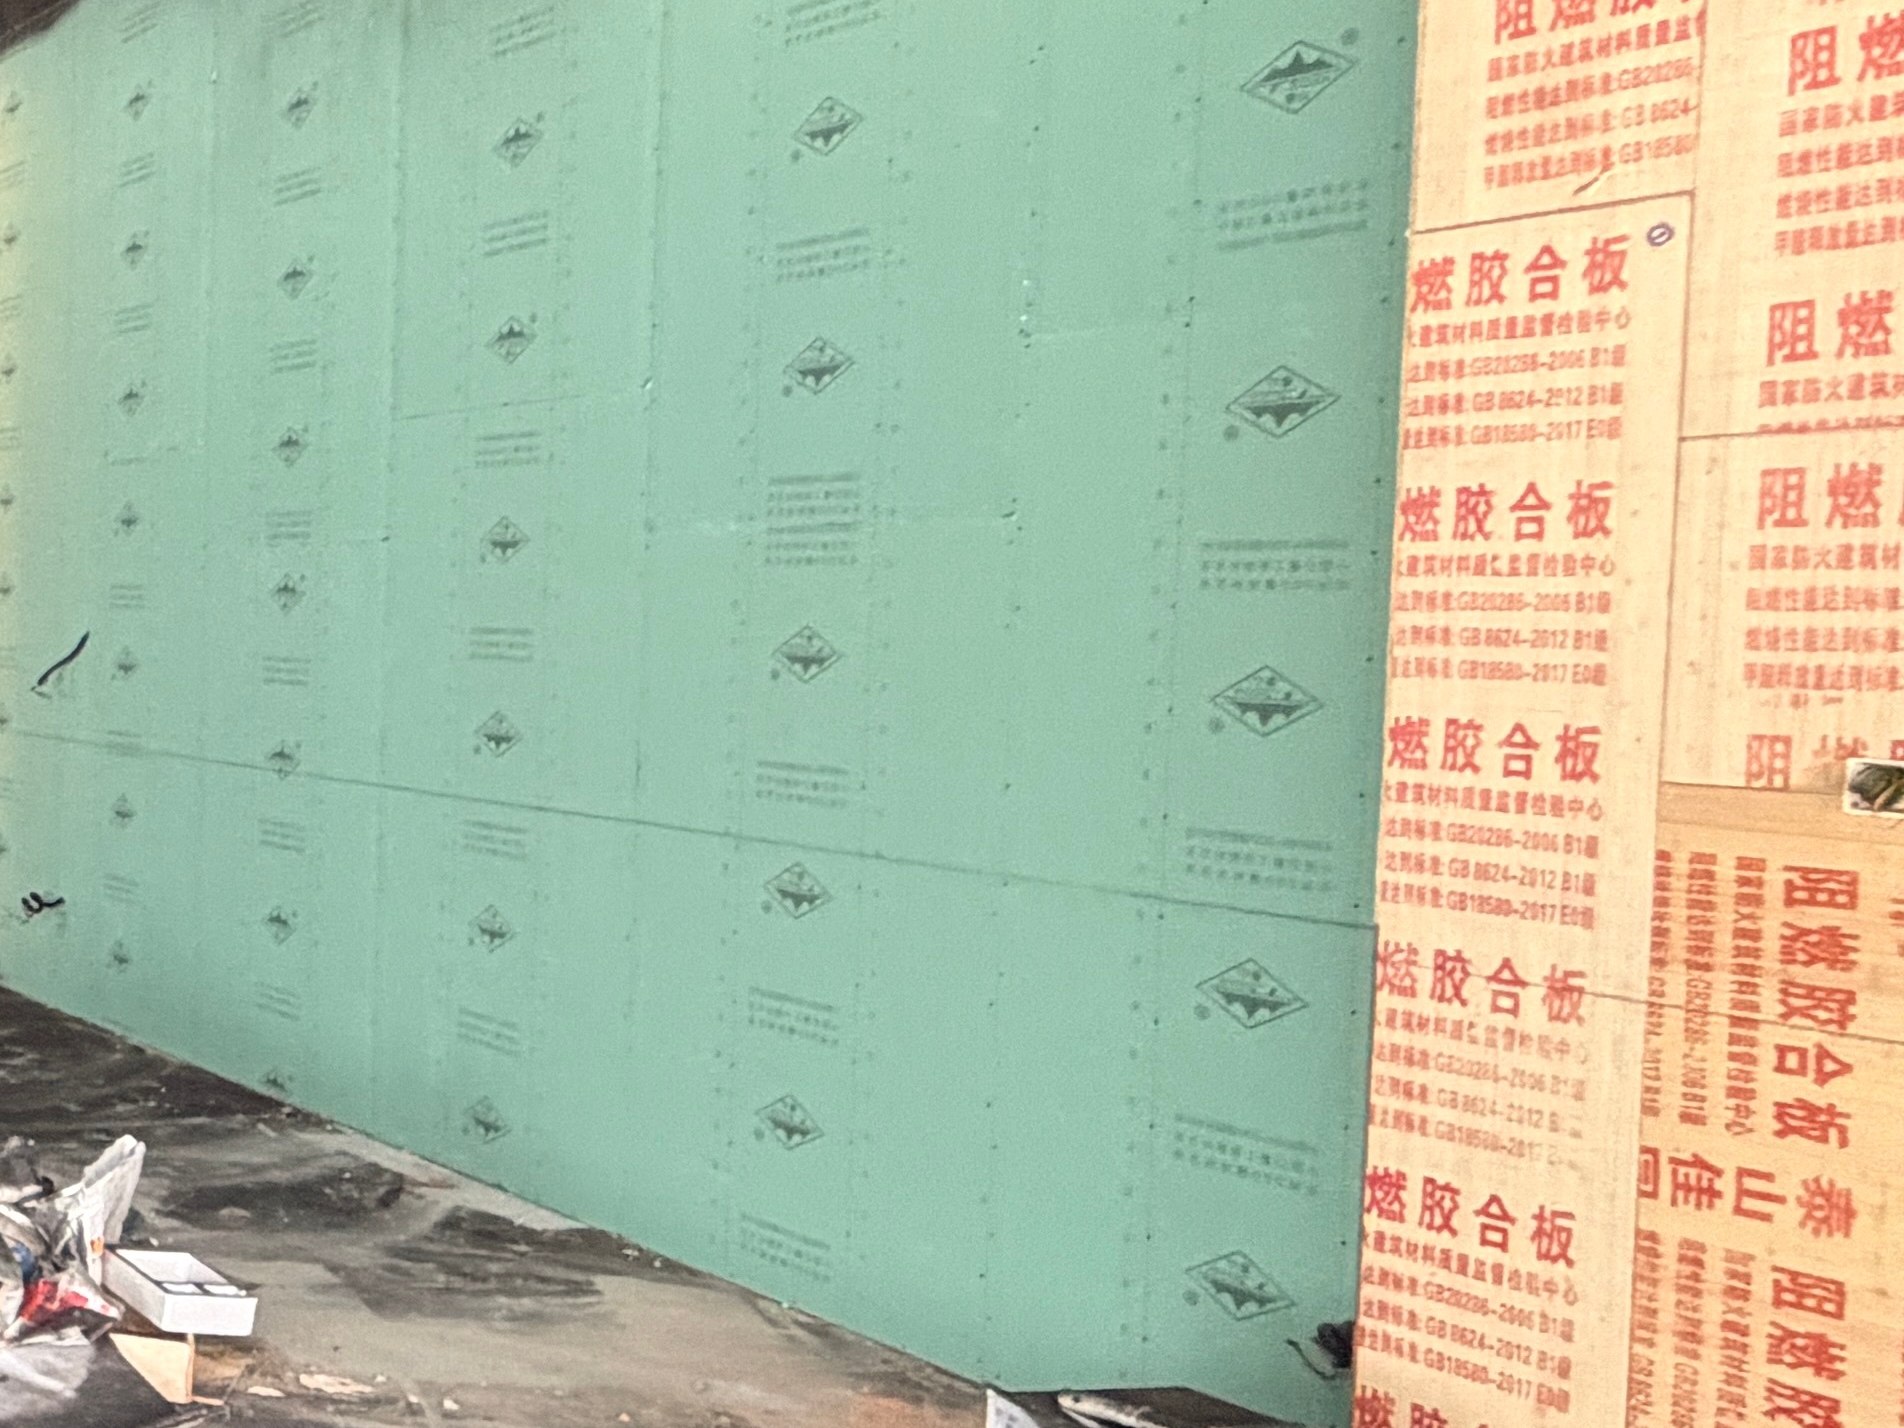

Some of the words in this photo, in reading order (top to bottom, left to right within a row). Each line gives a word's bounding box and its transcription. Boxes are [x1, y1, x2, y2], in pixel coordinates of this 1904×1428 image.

[1410, 234, 1631, 314] 燃胶合板
[1766, 290, 1894, 367] 阻燃
[1398, 480, 1616, 543] 燃胶合板
[1757, 462, 1904, 530] 阻燃
[1387, 715, 1602, 784] 燃胶合板
[1375, 940, 1586, 1027] 燃胶合板
[1773, 864, 1860, 1149] 阻燃胶合板
[1364, 1166, 1578, 1269] 燃胶合板
